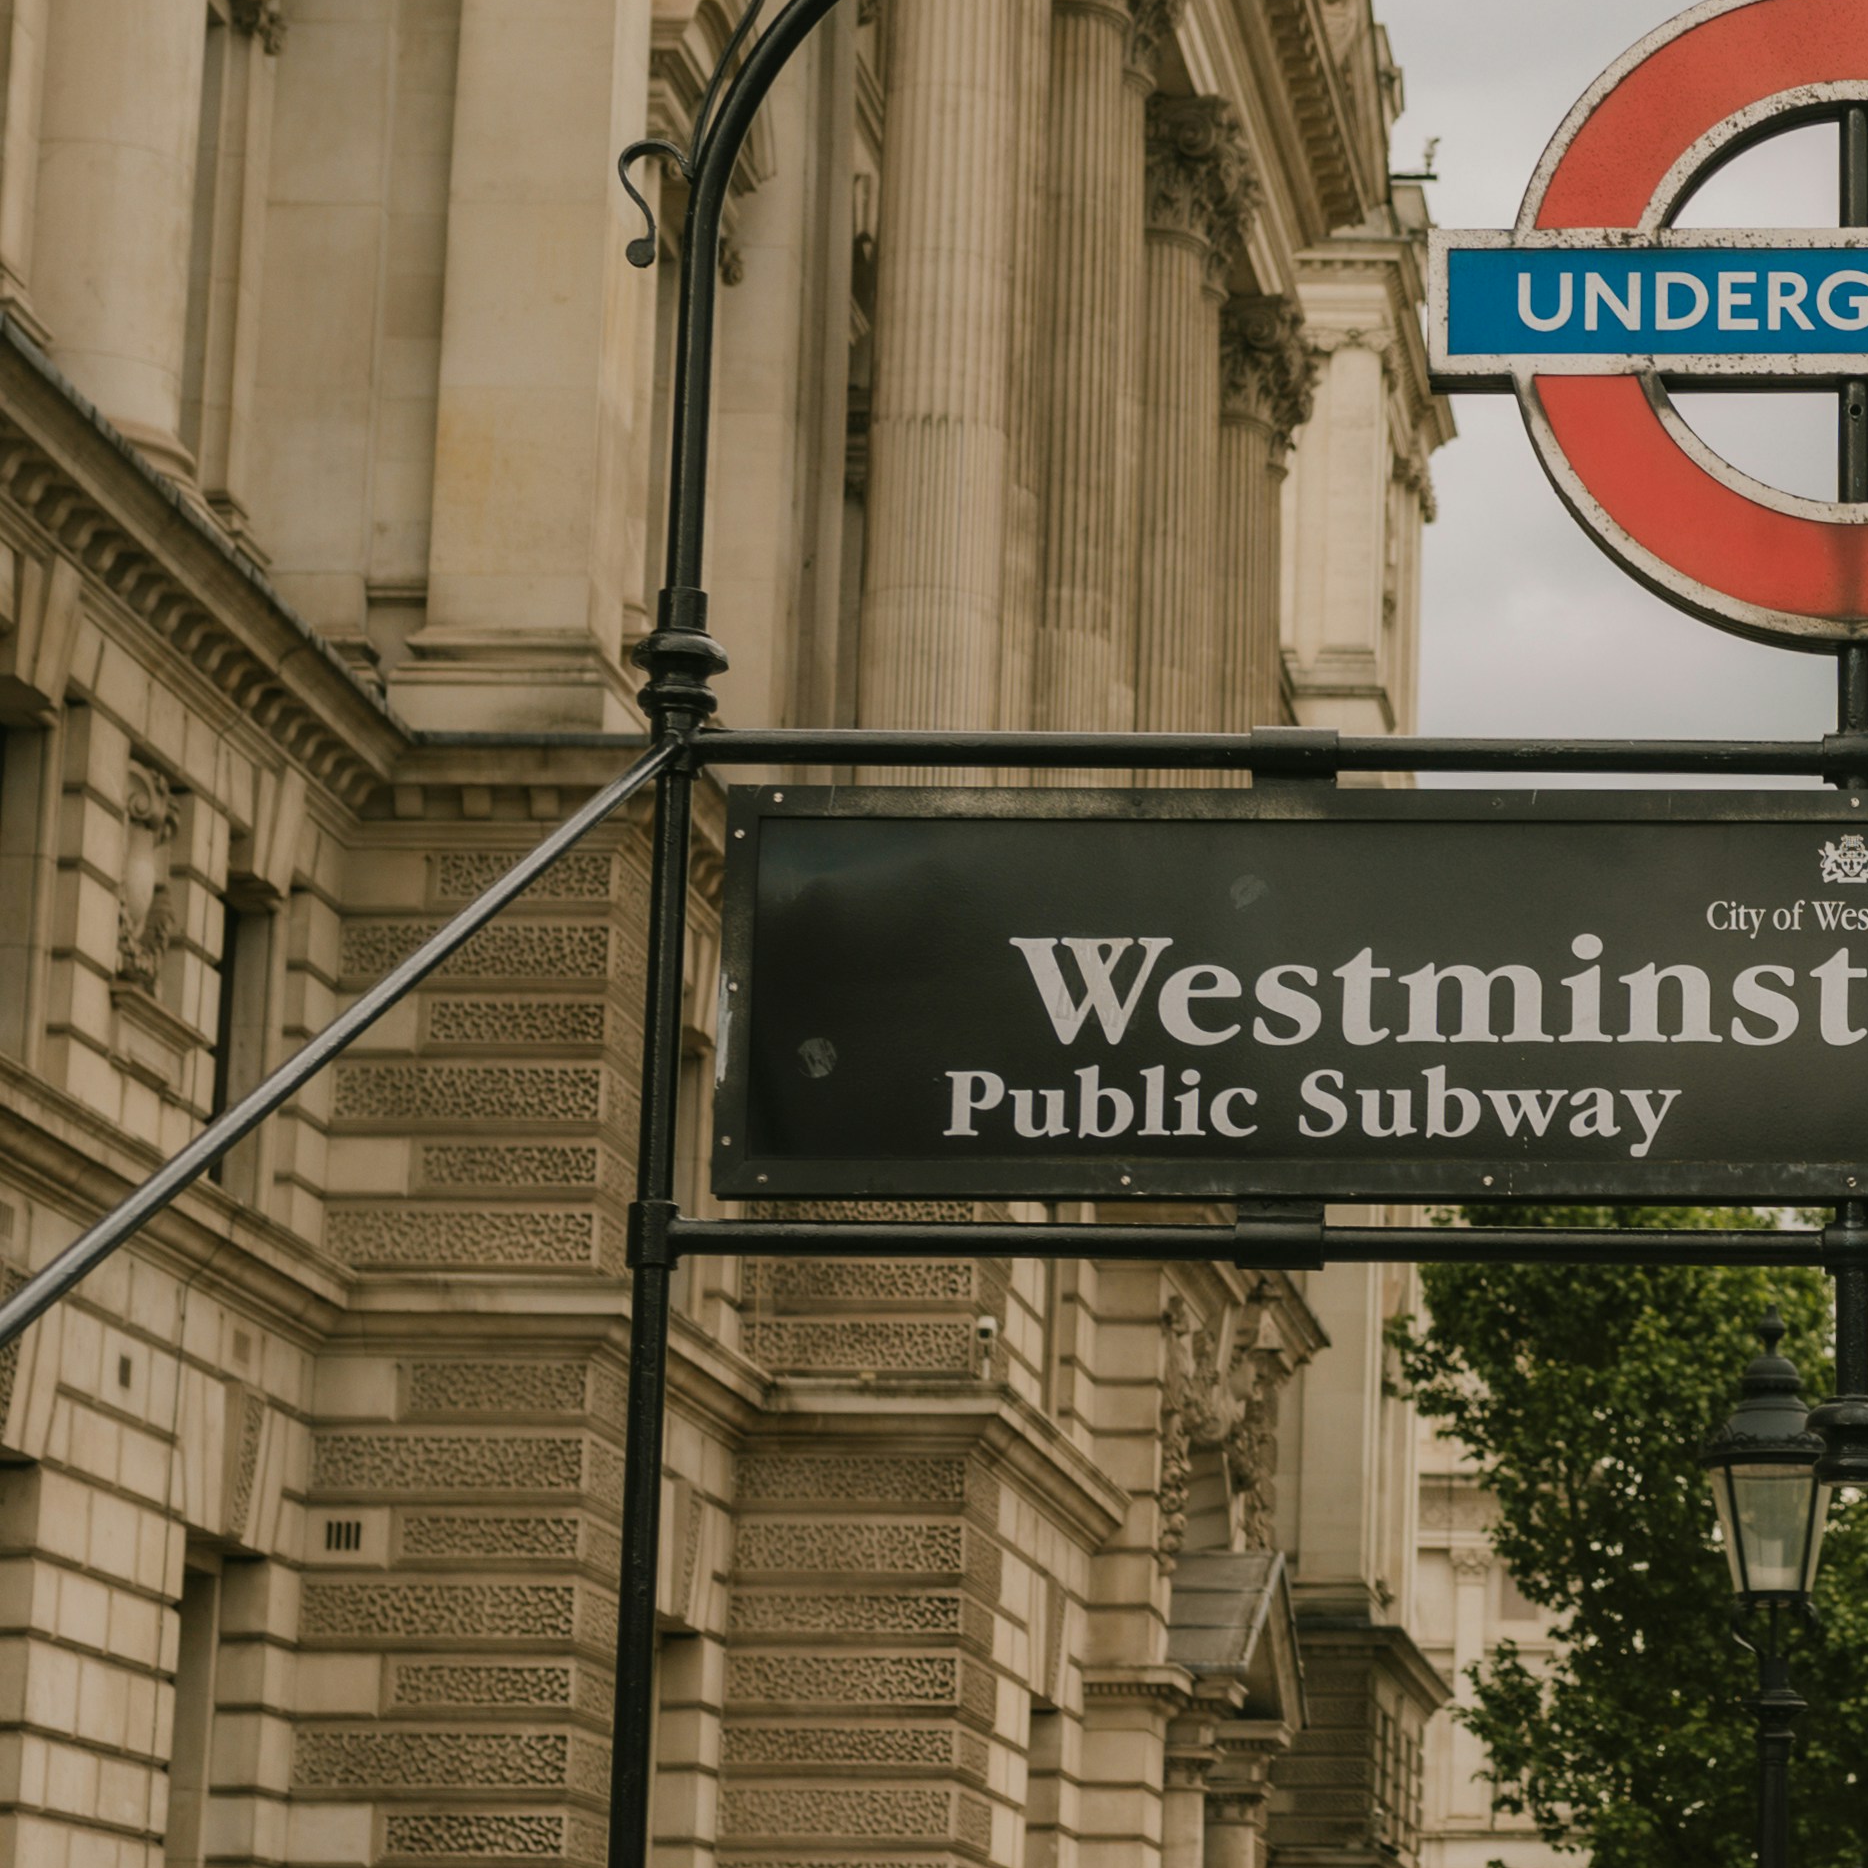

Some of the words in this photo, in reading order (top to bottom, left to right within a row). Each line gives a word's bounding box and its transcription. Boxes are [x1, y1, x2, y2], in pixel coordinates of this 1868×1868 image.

[1706, 900, 1766, 940] City
[1772, 899, 1806, 931] of
[942, 1064, 1258, 1139] Public
[1298, 1064, 1683, 1158] Subway
